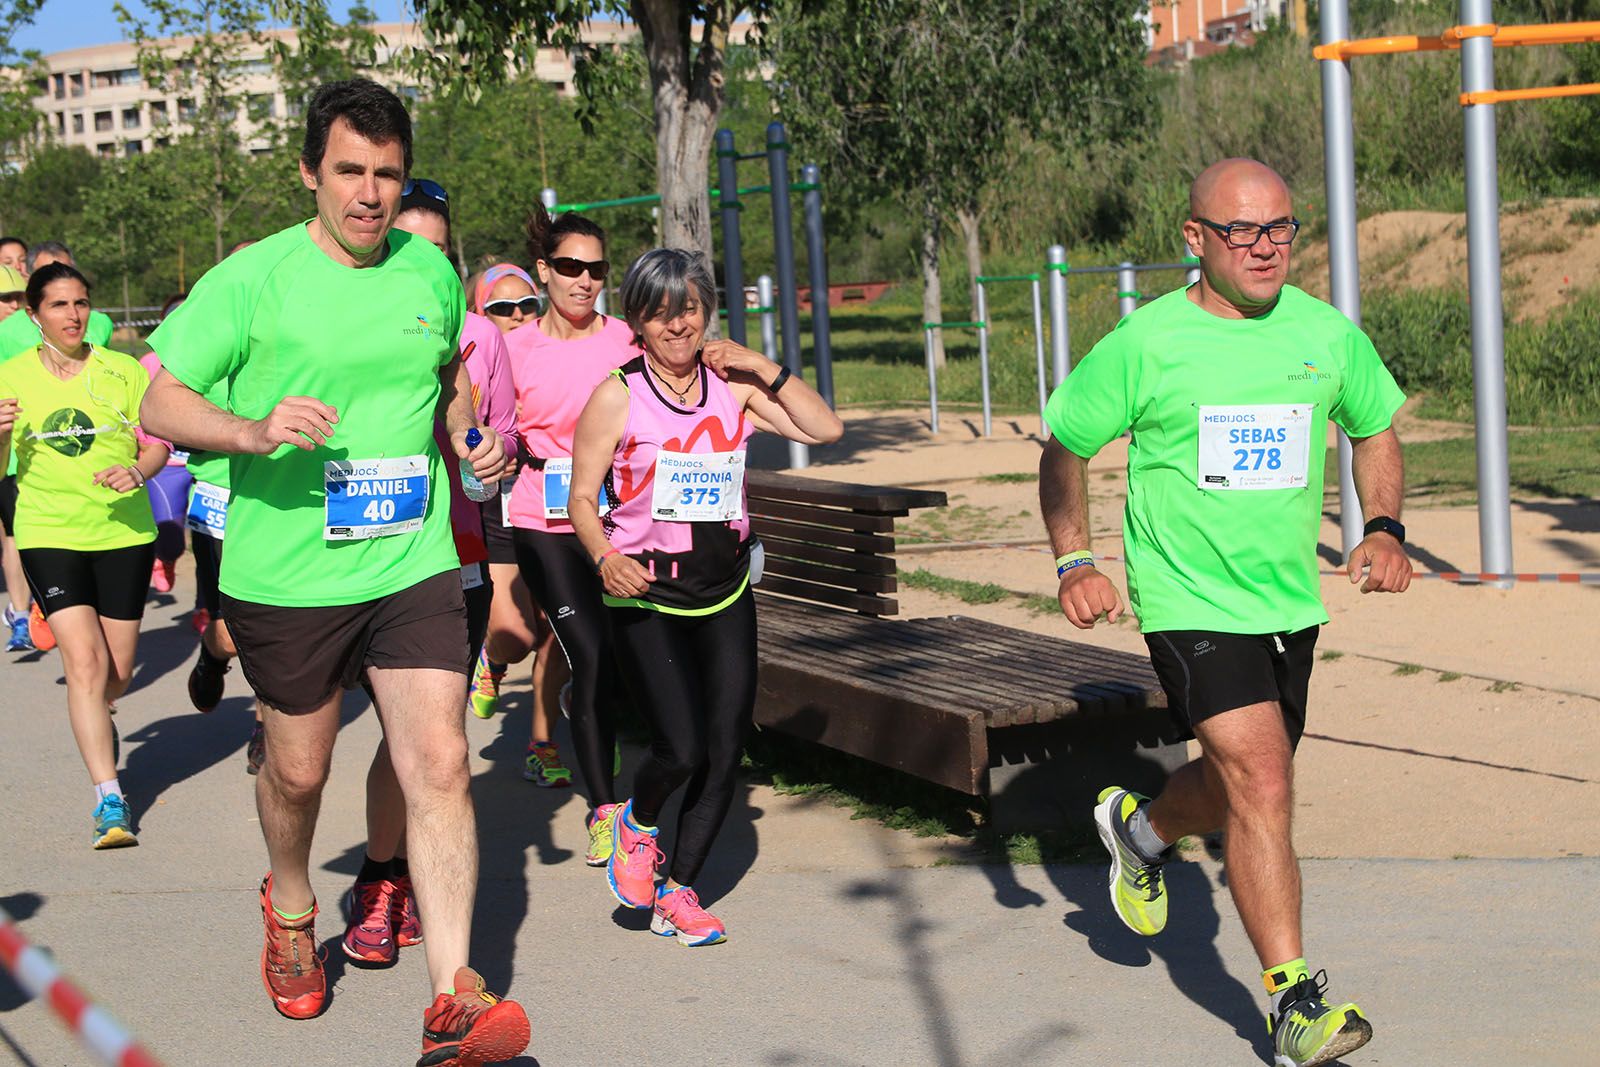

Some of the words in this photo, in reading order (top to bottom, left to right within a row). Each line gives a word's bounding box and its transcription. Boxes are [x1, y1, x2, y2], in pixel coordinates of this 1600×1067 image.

[1204, 414, 1256, 423] MEDIJOCS
[1229, 428, 1286, 443] SEBAS
[659, 457, 704, 468] MEDIJOCS
[1233, 448, 1281, 470] 278
[329, 467, 378, 478] MEDIJOCS
[670, 472, 733, 483] ANTONIA
[346, 480, 412, 497] DANIEL
[680, 488, 720, 505] 375
[363, 499, 395, 521] 40
